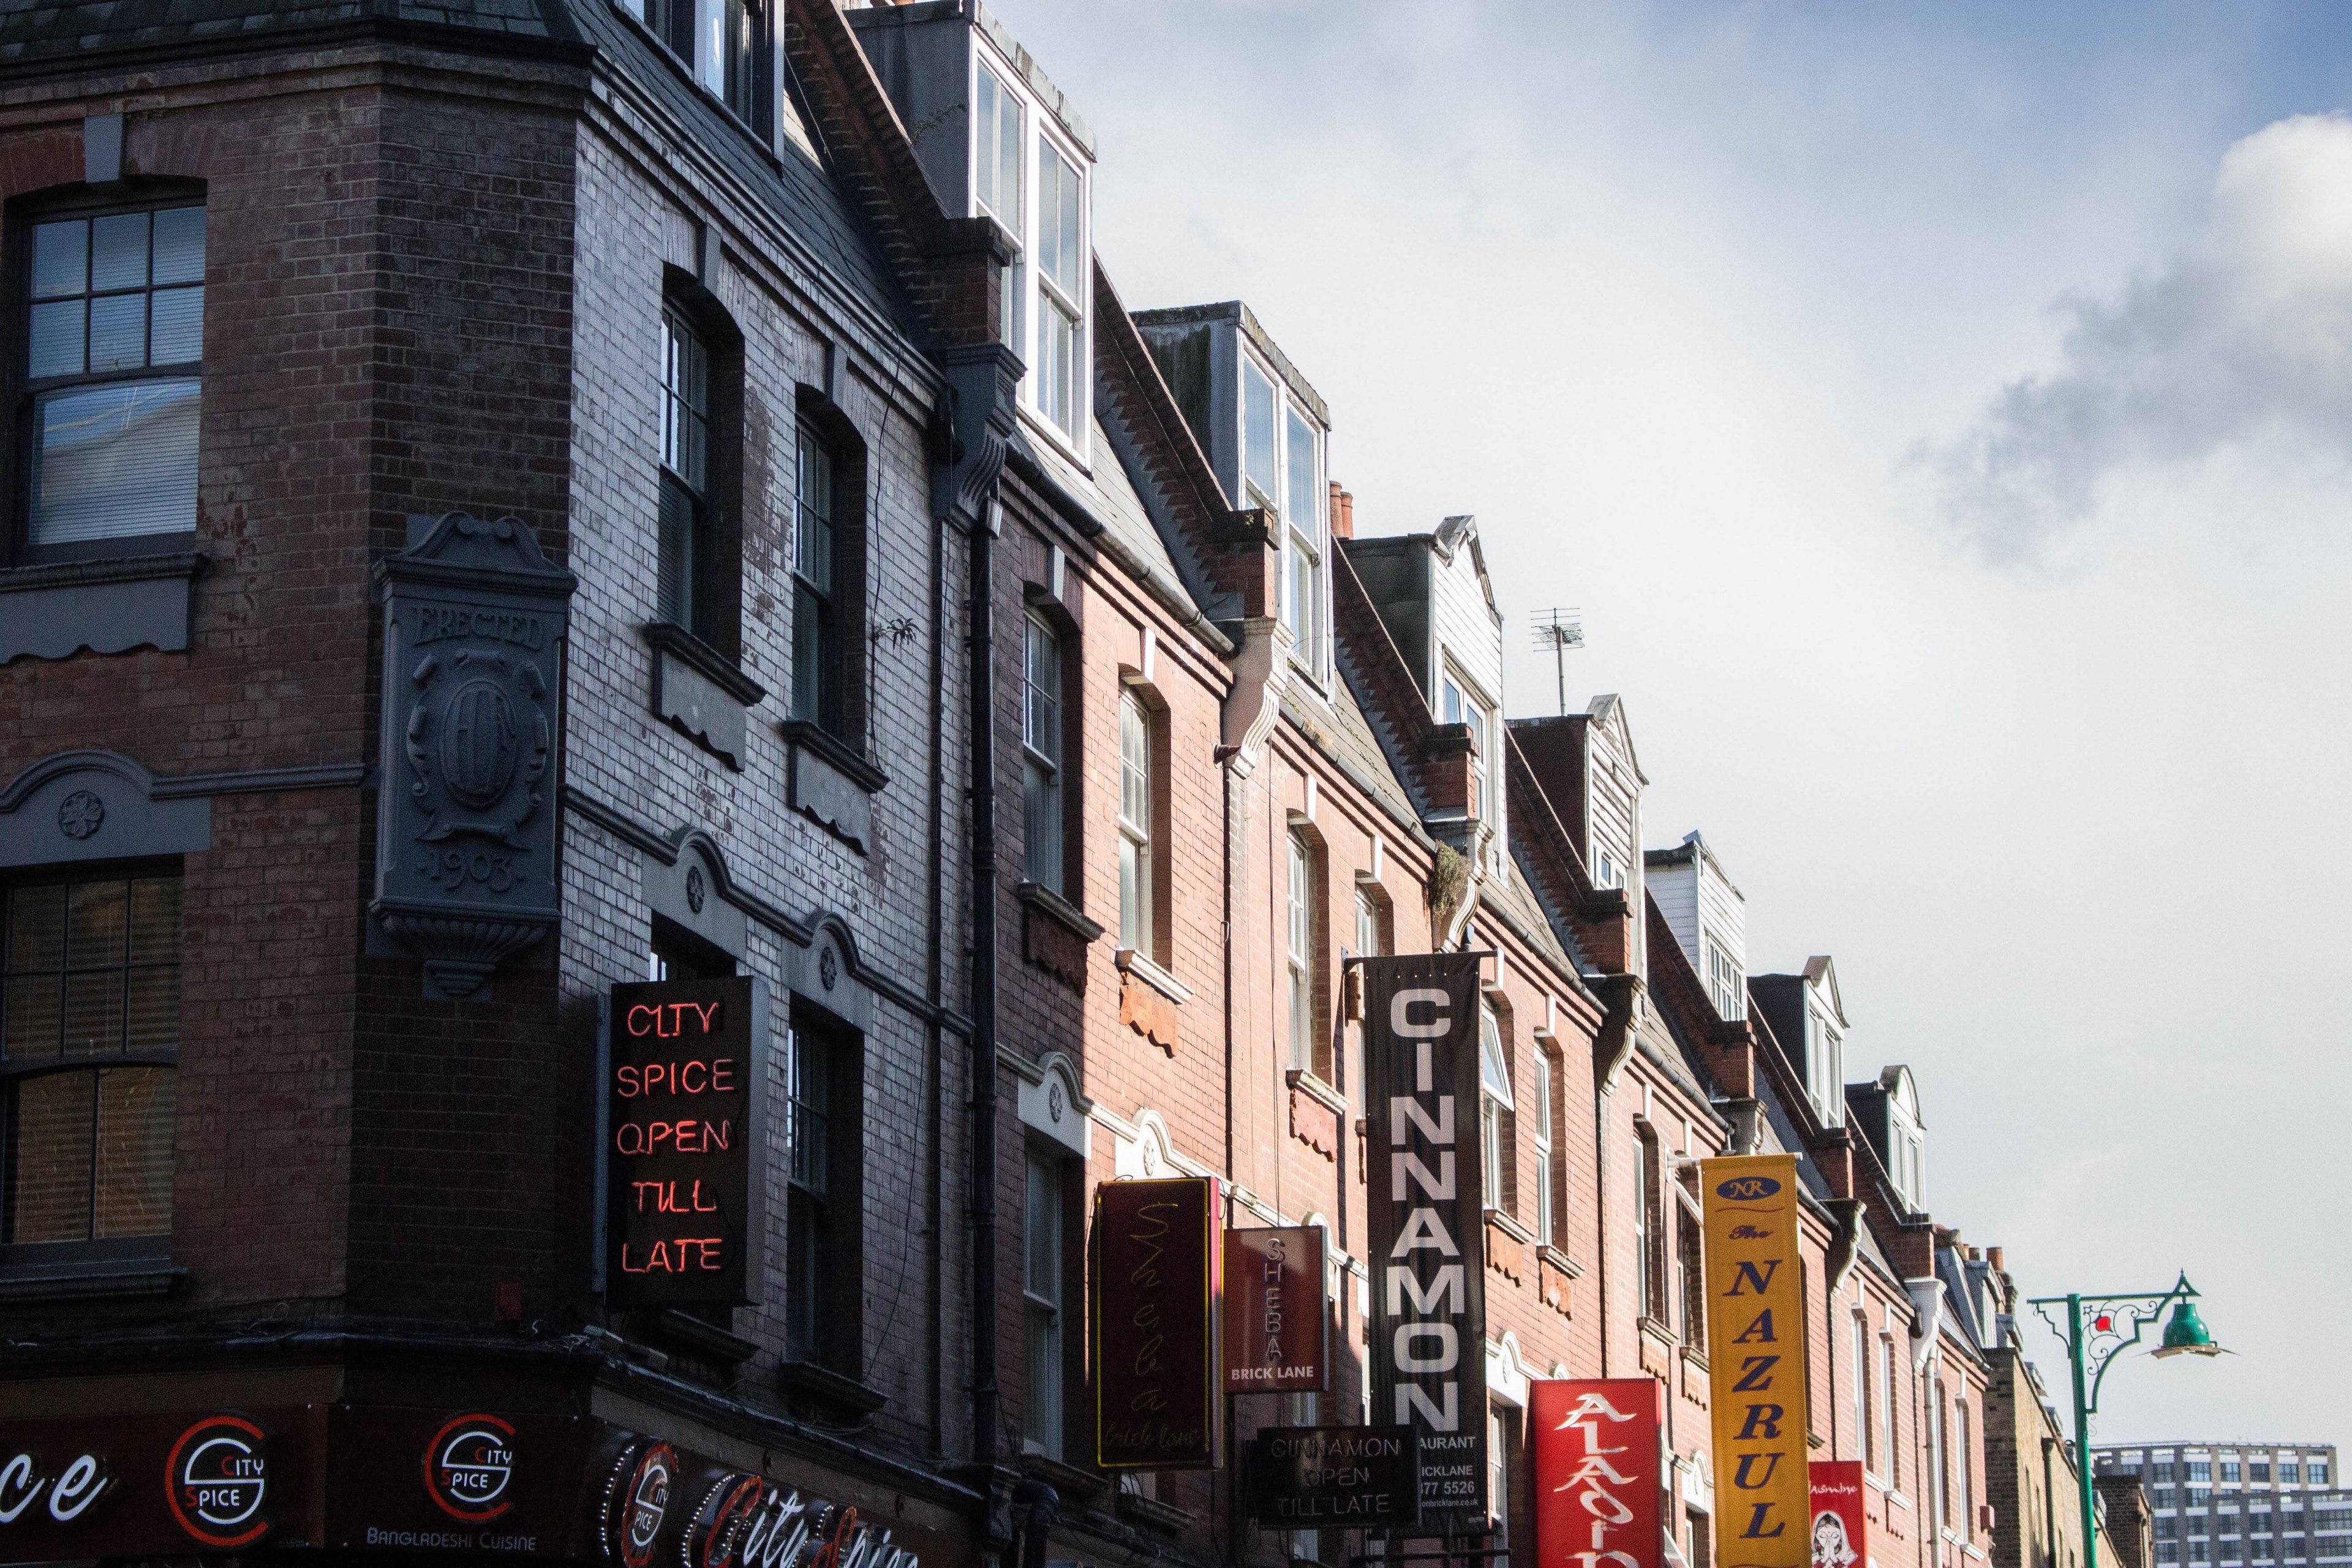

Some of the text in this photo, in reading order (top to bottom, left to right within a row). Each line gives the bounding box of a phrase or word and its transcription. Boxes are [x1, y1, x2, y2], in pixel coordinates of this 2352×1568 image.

[414, 608, 542, 652] ERECTED
[428, 851, 513, 893] 1903
[627, 1002, 719, 1037] CITY
[617, 1058, 734, 1098] SPICE
[617, 1120, 730, 1155] OPEN
[631, 1180, 717, 1213] TILL
[1387, 988, 1464, 1432] CINNAMON
[1728, 1224, 1774, 1240] The
[622, 1238, 722, 1273] LATE
[1264, 1237, 1286, 1359] SHEBA
[1231, 1365, 1314, 1381] BRICK LANE
[1722, 1259, 1786, 1539] NAZRUL
[1270, 1438, 1401, 1459] CINNAMON
[1307, 1466, 1370, 1488] OPEN
[1420, 1480, 1475, 1495] 77 5526
[1276, 1493, 1391, 1517] TILL LATE
